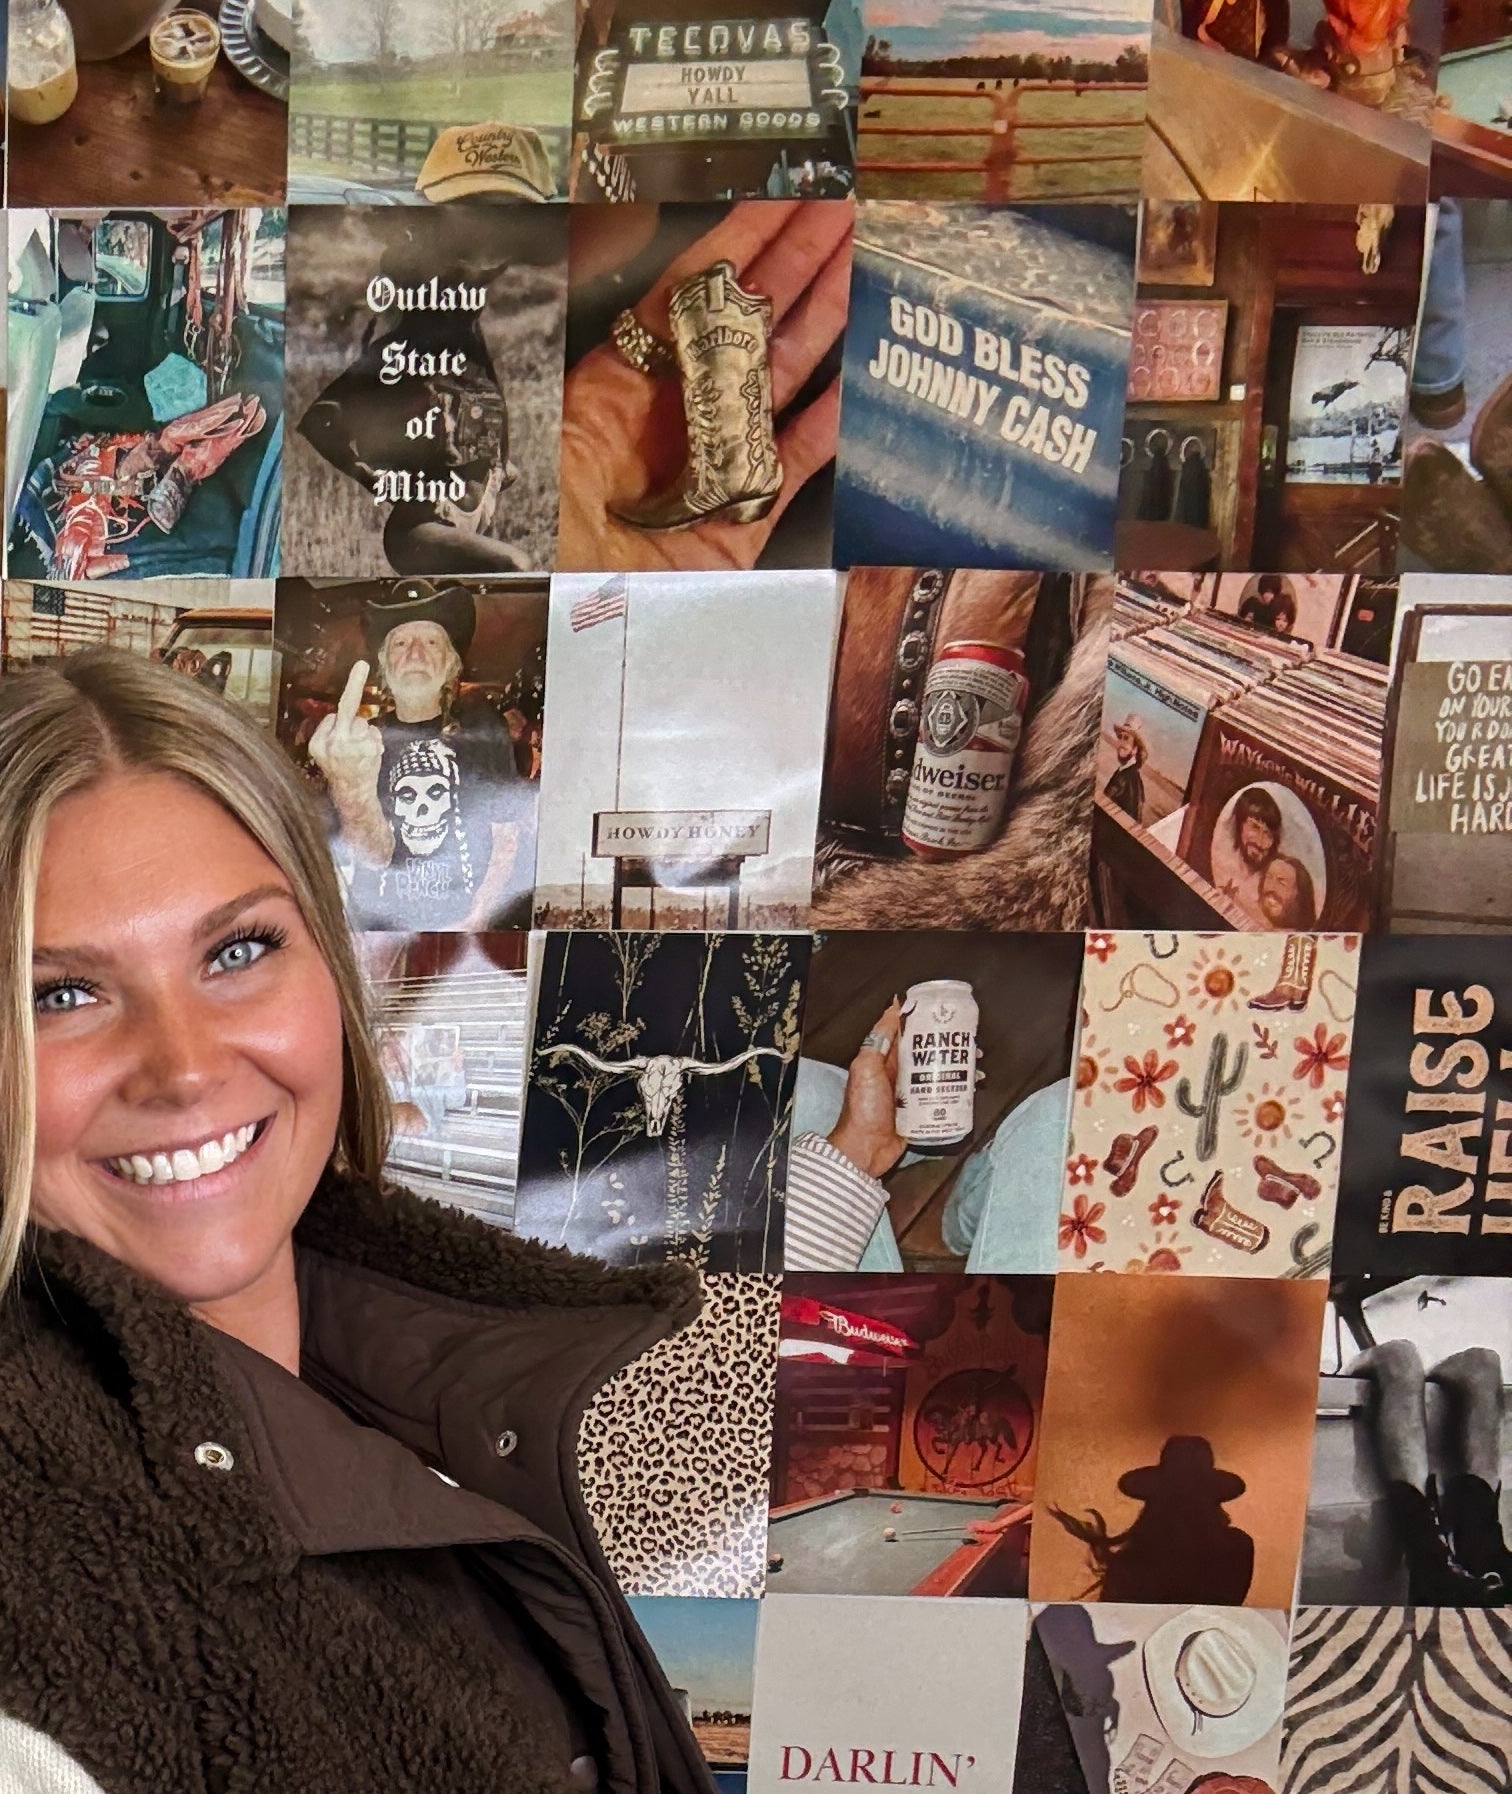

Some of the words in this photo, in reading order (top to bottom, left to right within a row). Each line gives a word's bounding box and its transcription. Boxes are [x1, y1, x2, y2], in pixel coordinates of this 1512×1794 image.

[629, 21, 811, 56] TECOVAS
[681, 66, 746, 83] HOWDY
[688, 86, 739, 105] YALL
[613, 114, 729, 134] WESTERN
[739, 112, 822, 130] GOODS
[367, 276, 487, 313] Outlaw
[379, 339, 468, 385] State
[890, 296, 964, 356] GOD
[974, 327, 1091, 409] BLESS
[404, 406, 442, 440] of
[869, 339, 1002, 426] JOHNNY
[1000, 395, 1098, 474] CASH
[372, 469, 466, 507] Mind
[1447, 660, 1482, 694] GO
[1439, 696, 1467, 719] ON
[913, 757, 1006, 791] dweiser
[1445, 743, 1512, 773] GREA
[1416, 770, 1467, 804] LIFE
[1472, 773, 1497, 802] IS
[607, 826, 684, 841] HOWDY
[687, 824, 761, 839] HONEY
[912, 1031, 971, 1050] RANCH
[912, 1049, 969, 1067] WATER
[919, 1072, 961, 1083] ORGINAL
[1392, 984, 1495, 1235] RAISE
[779, 1744, 976, 1788] DARLIN’
